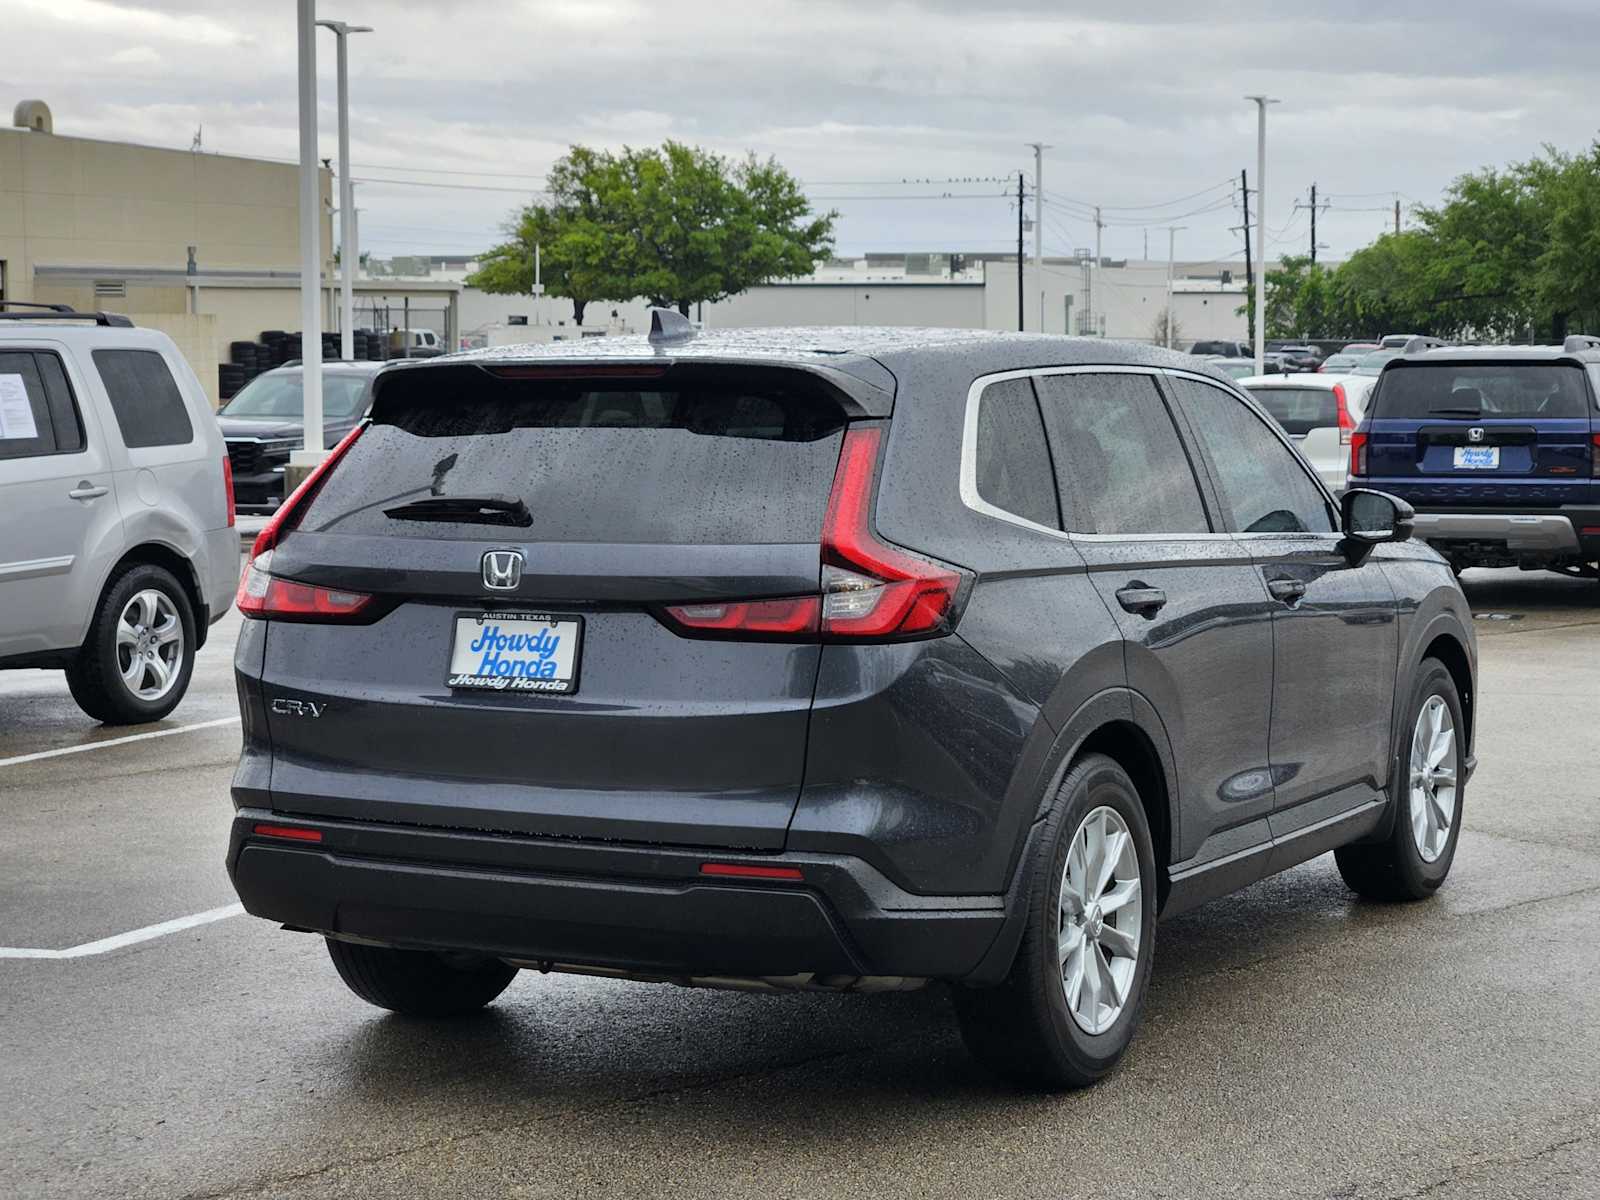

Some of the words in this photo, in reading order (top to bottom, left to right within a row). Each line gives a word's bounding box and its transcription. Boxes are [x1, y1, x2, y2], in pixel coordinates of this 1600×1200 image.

[482, 612, 517, 620] AUSTIN
[521, 613, 552, 621] TEXAS
[470, 625, 560, 659] Howdy
[478, 651, 558, 679] Honda
[448, 674, 511, 689] Howdy
[511, 677, 569, 691] Honda
[271, 698, 328, 718] CR-V
